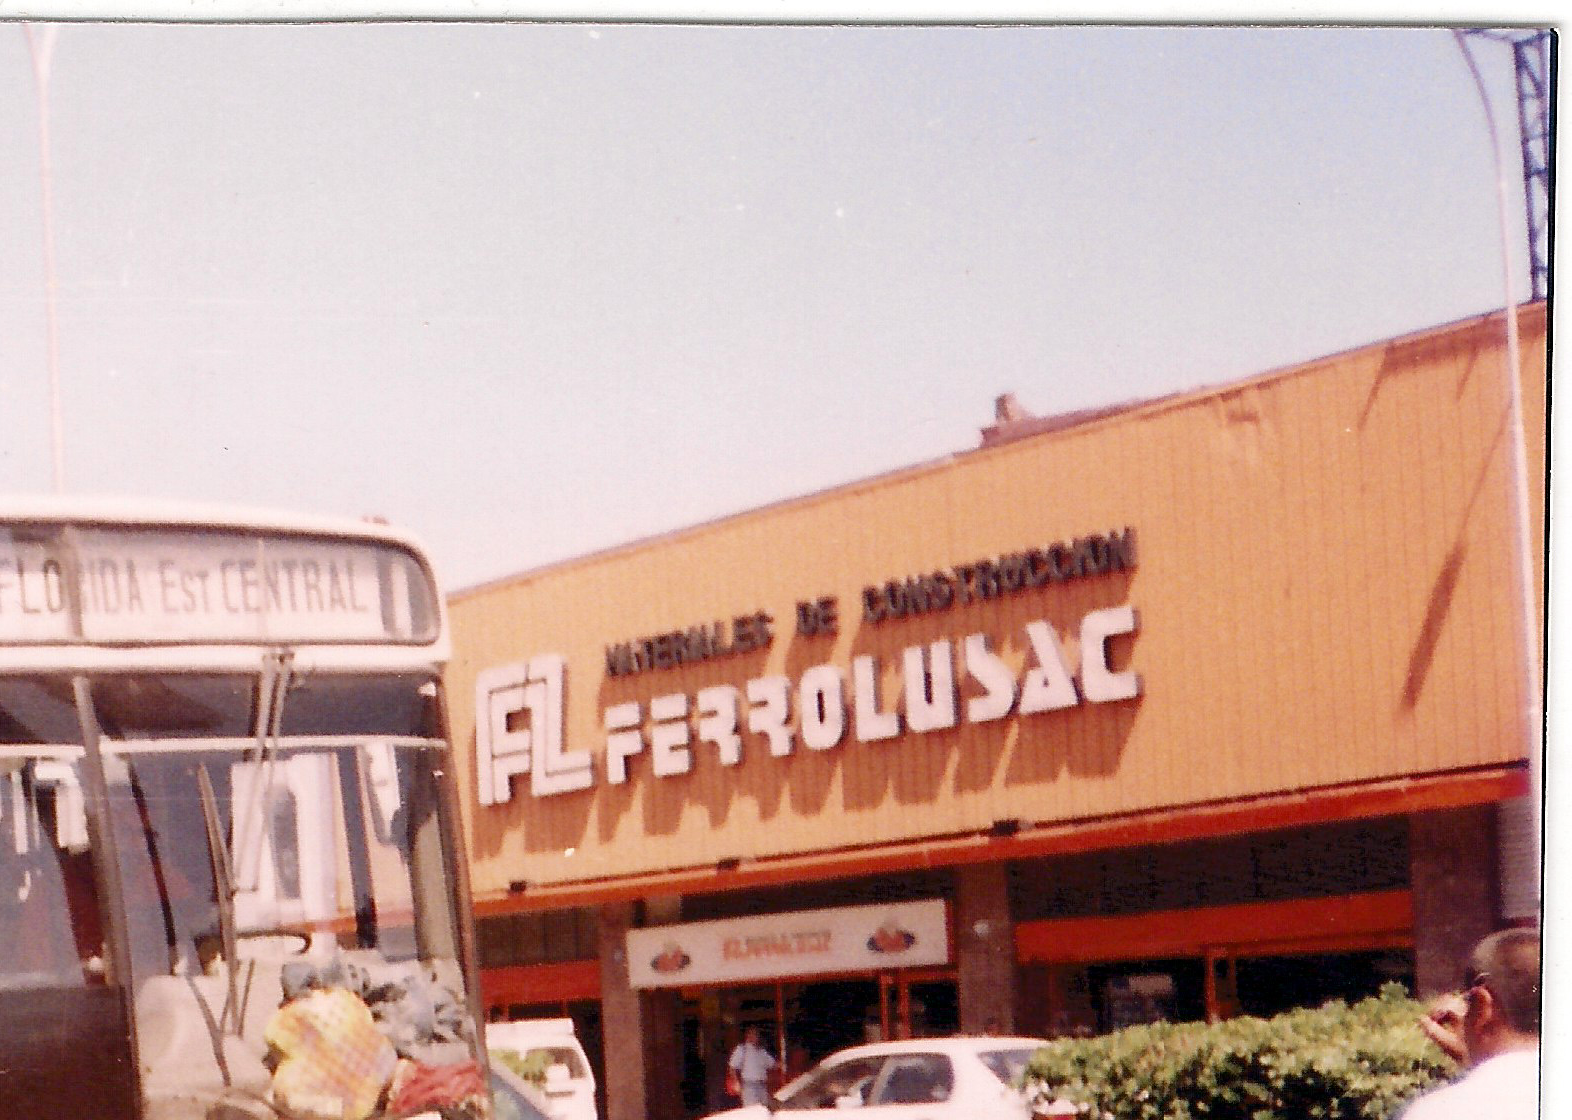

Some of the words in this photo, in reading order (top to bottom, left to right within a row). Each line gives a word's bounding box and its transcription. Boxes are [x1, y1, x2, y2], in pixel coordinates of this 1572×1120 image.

[220, 557, 369, 613] CENTRAL
[795, 593, 840, 637] DE
[604, 604, 1142, 786] FERROLUSAC
